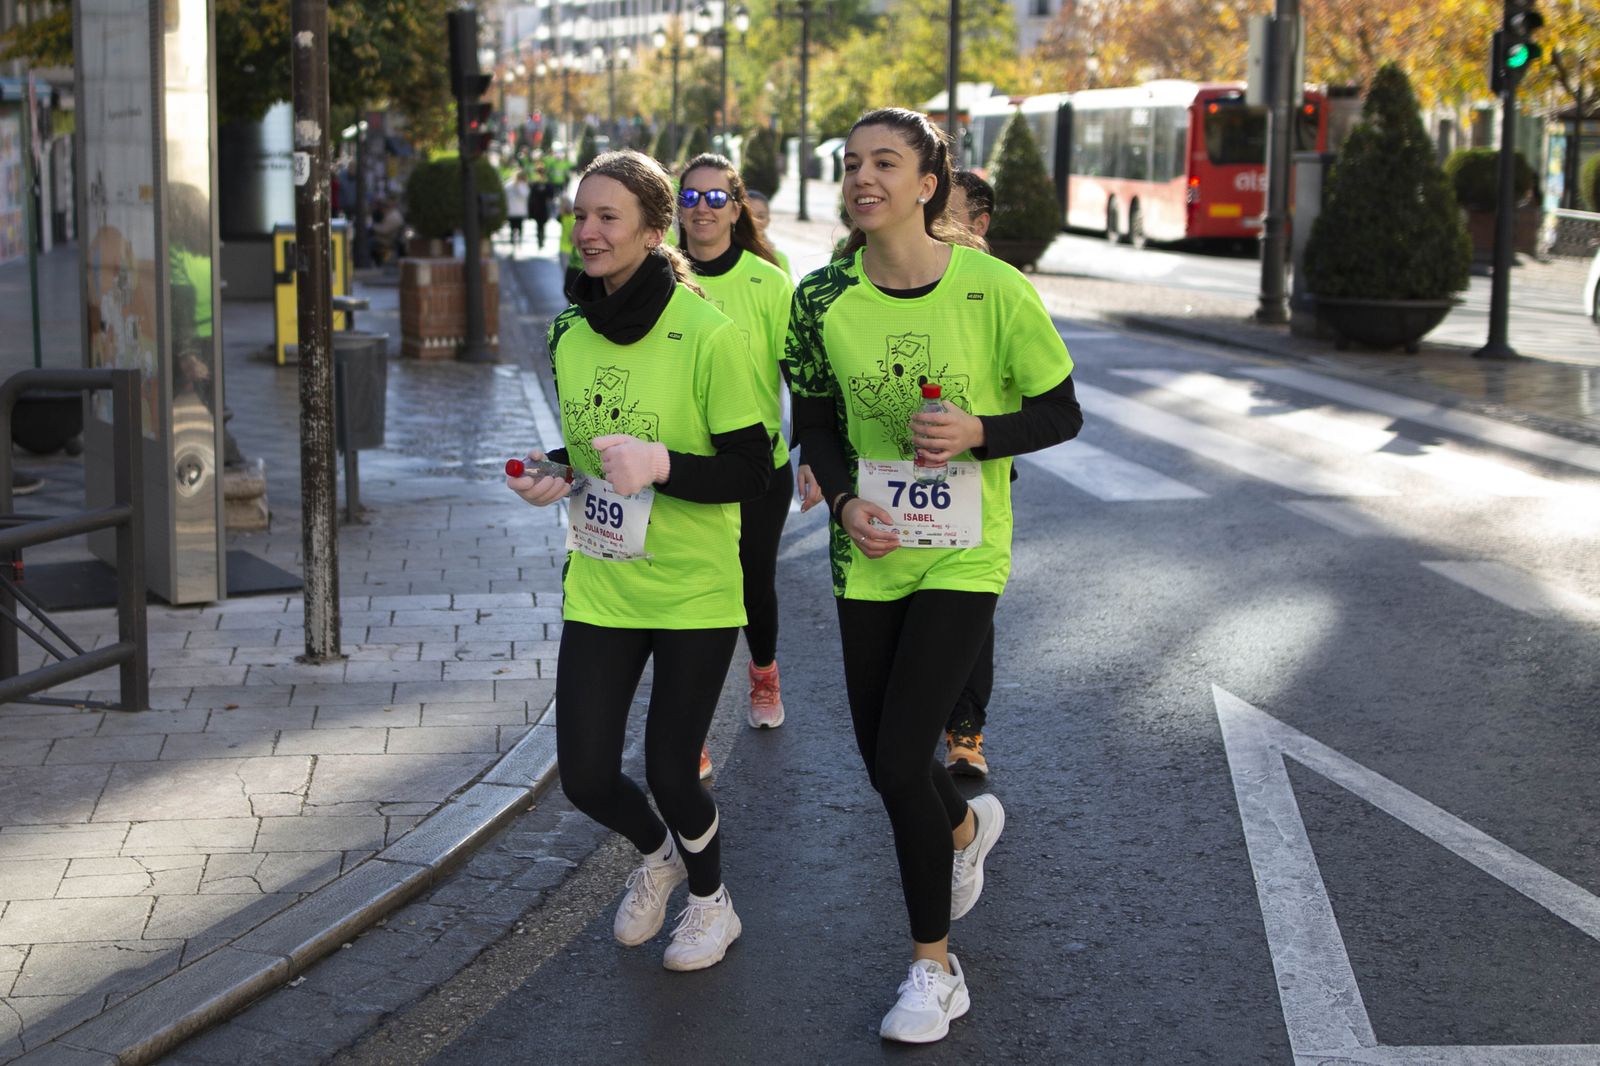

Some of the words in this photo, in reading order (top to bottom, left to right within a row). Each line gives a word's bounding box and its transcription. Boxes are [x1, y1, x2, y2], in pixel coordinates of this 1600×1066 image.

[1234, 171, 1268, 191] als
[887, 480, 951, 509] 766
[584, 493, 624, 529] 559
[903, 513, 935, 522] ISABEL
[584, 522, 600, 535] JULIA
[599, 528, 624, 542] PADILLA
